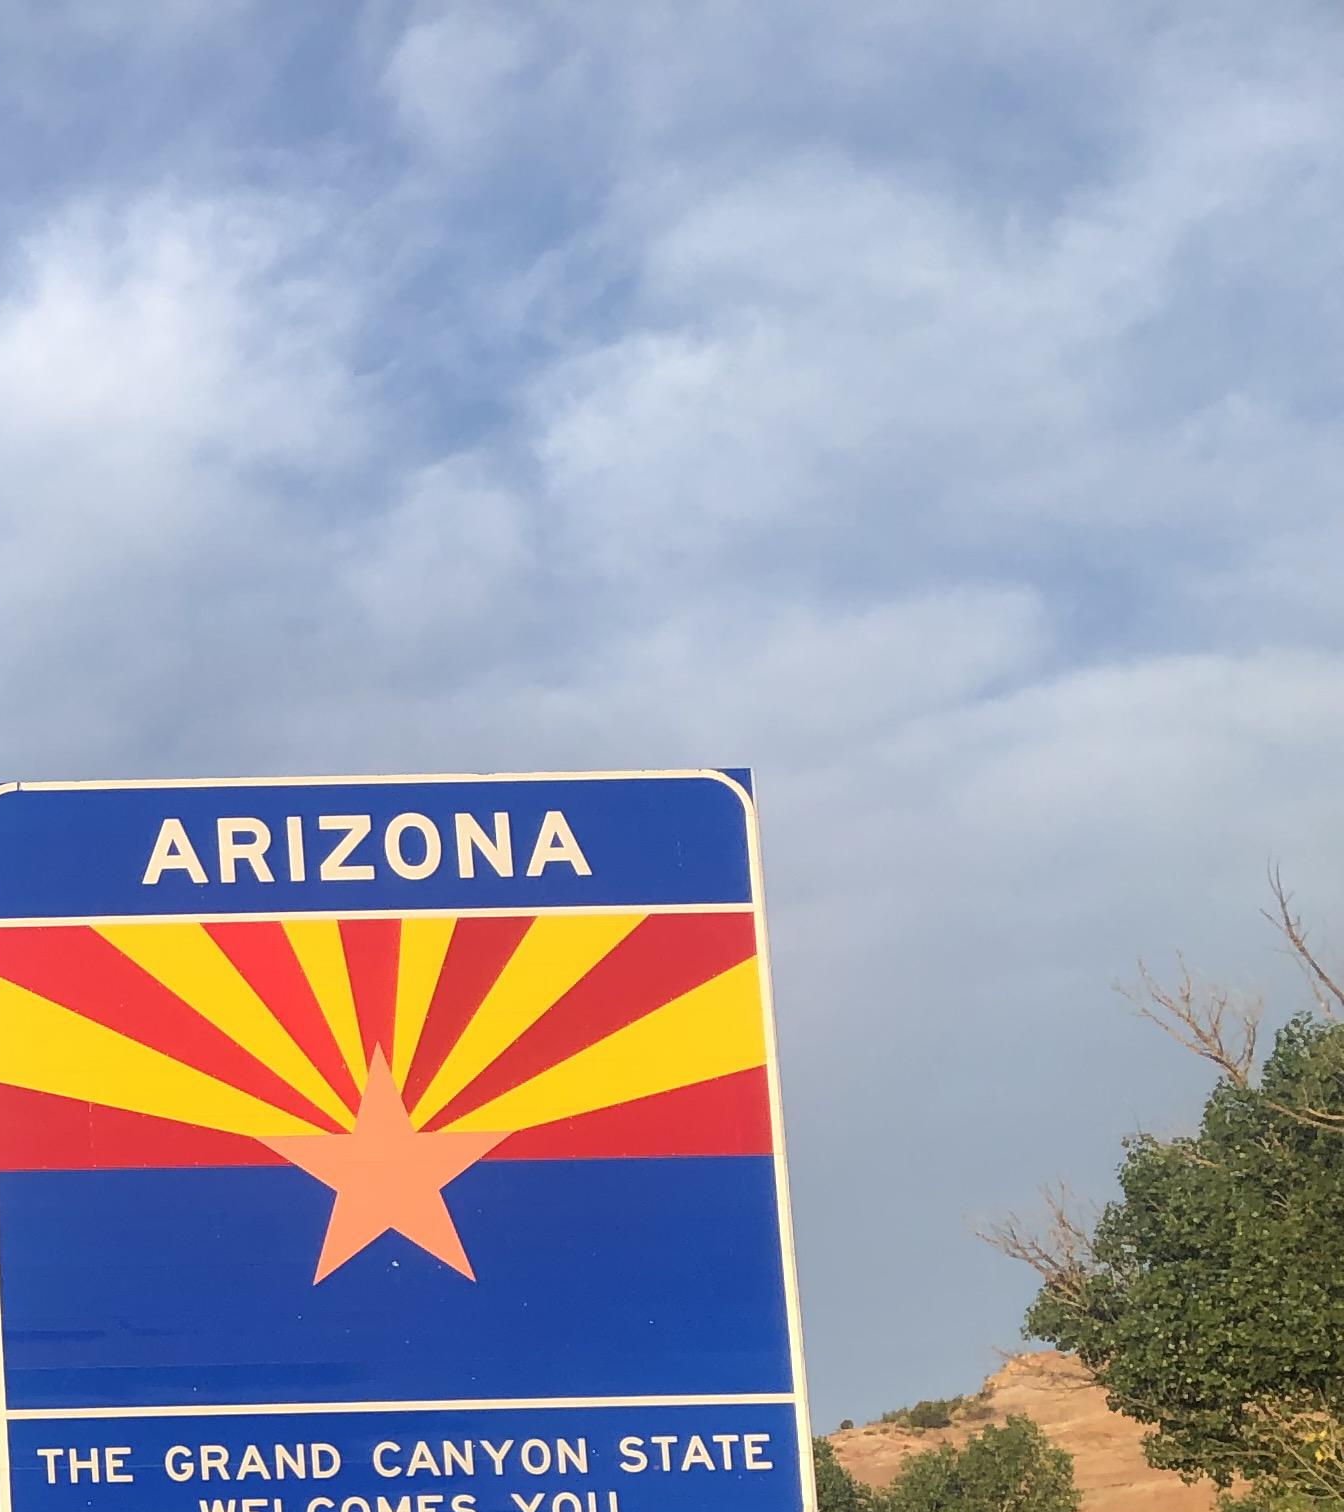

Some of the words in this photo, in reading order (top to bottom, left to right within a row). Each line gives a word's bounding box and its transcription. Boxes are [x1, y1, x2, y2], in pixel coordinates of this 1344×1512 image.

[141, 810, 593, 885] ARIZONA
[36, 1446, 134, 1485] THE
[164, 1442, 342, 1483] GRAND
[372, 1437, 589, 1479] CANYON
[619, 1433, 774, 1473] STATE
